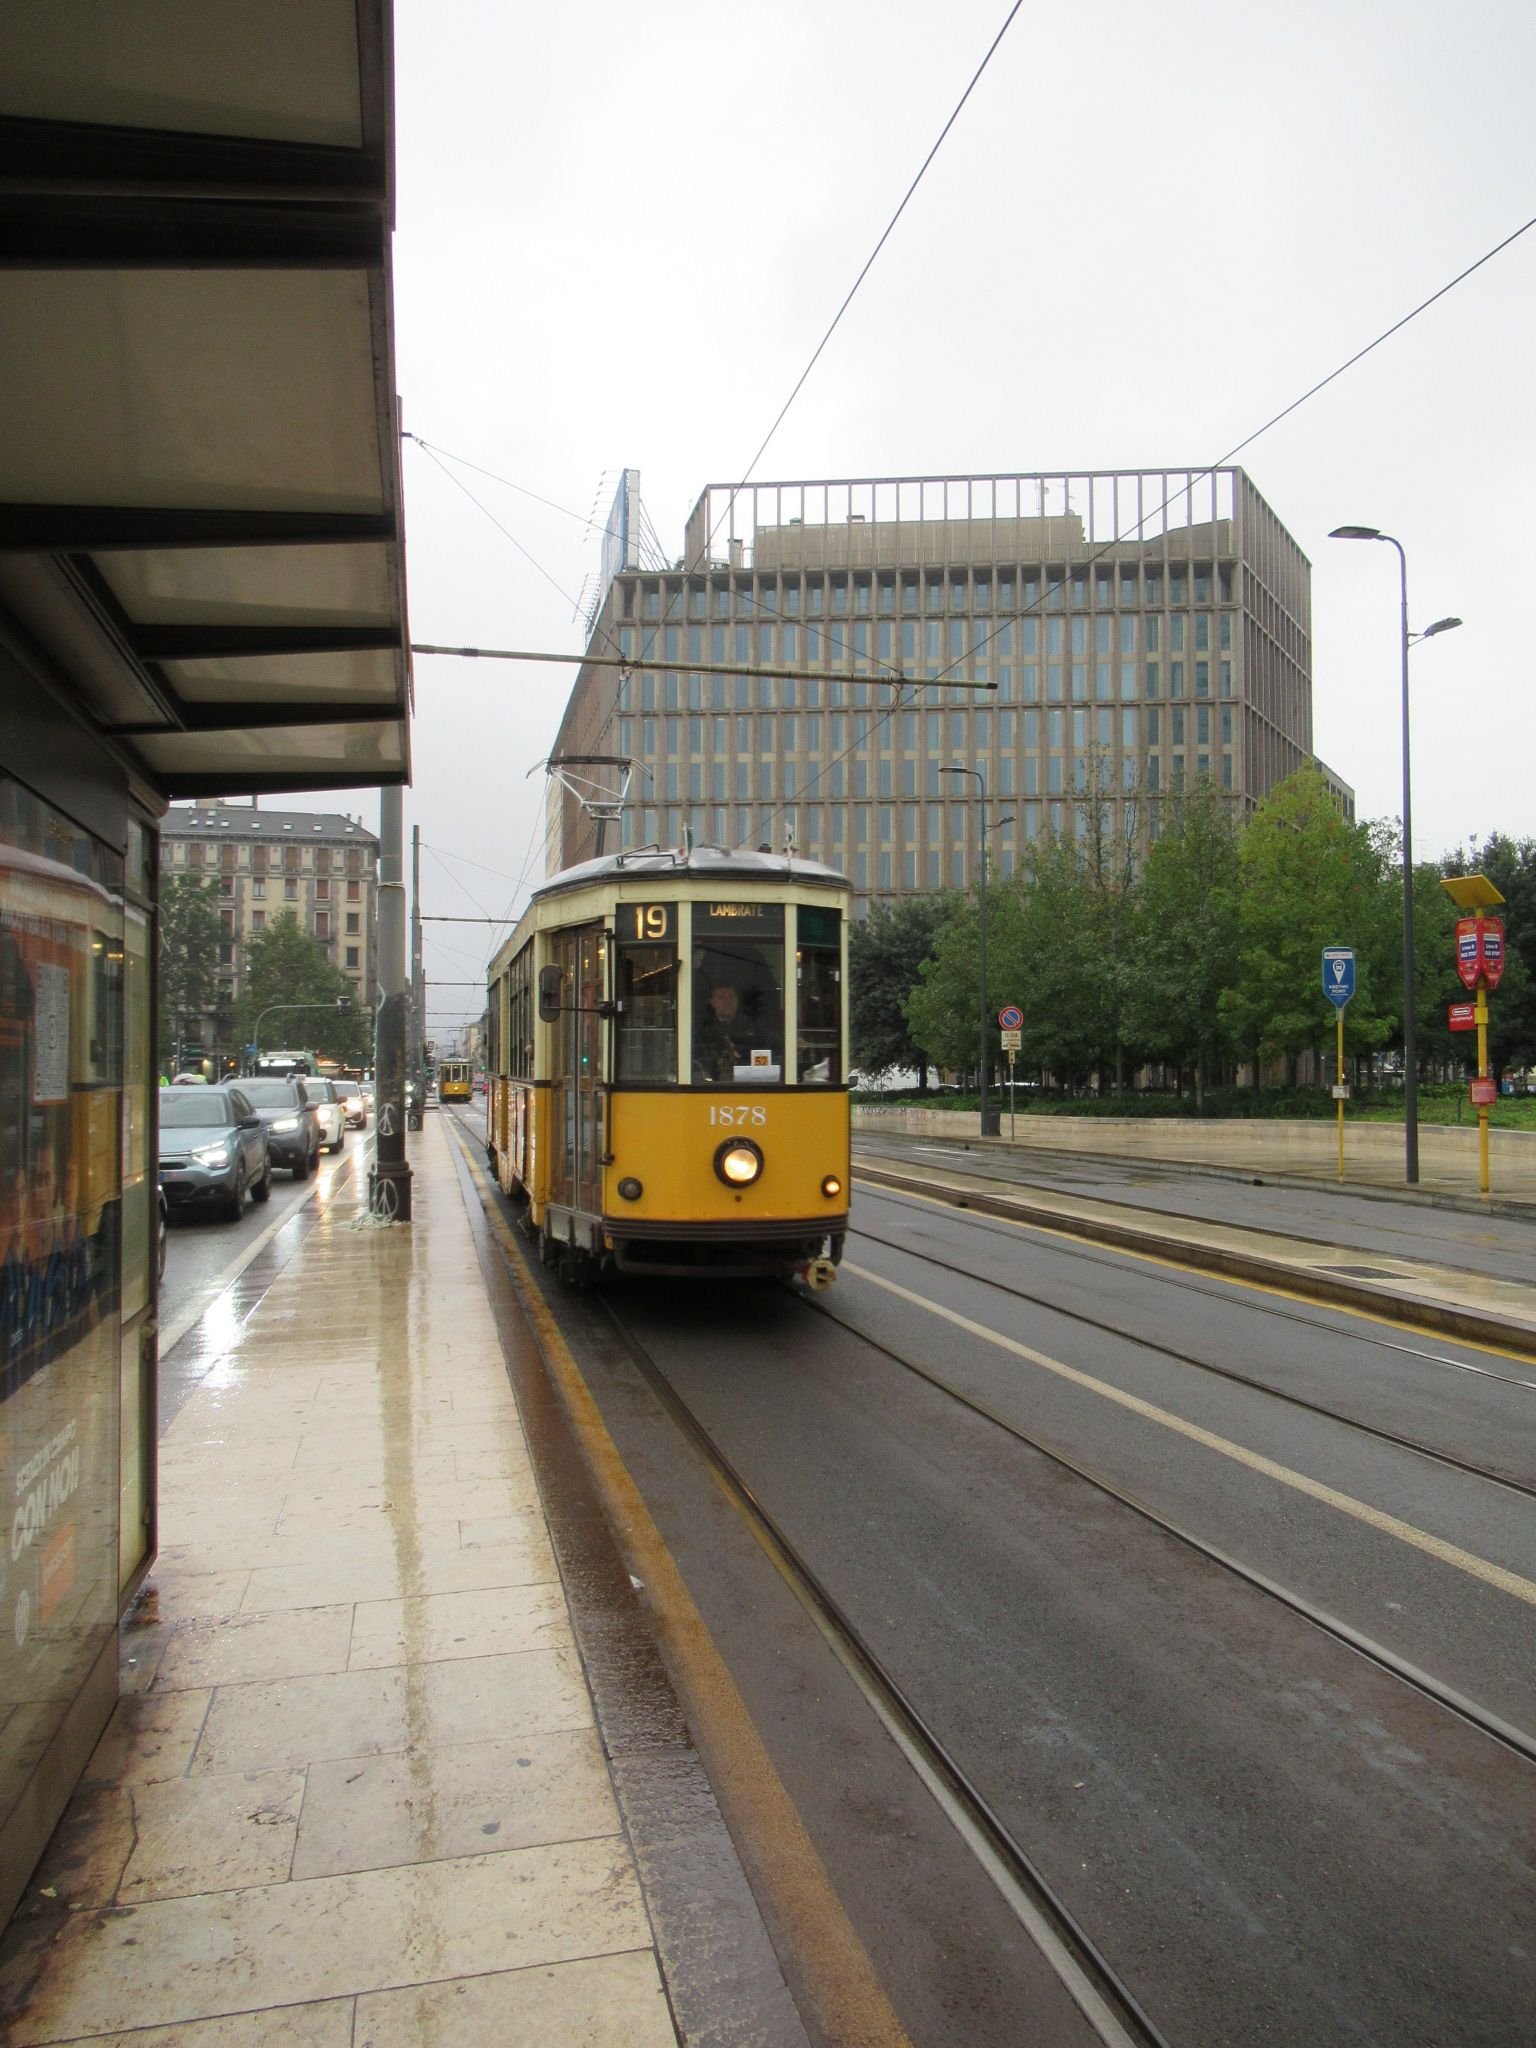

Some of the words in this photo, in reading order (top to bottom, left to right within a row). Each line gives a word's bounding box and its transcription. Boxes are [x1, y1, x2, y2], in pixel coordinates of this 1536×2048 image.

[635, 905, 667, 940] 19
[709, 904, 764, 917] LAMBRATE
[709, 1105, 767, 1127] 1878
[11, 1478, 48, 1563] CON
